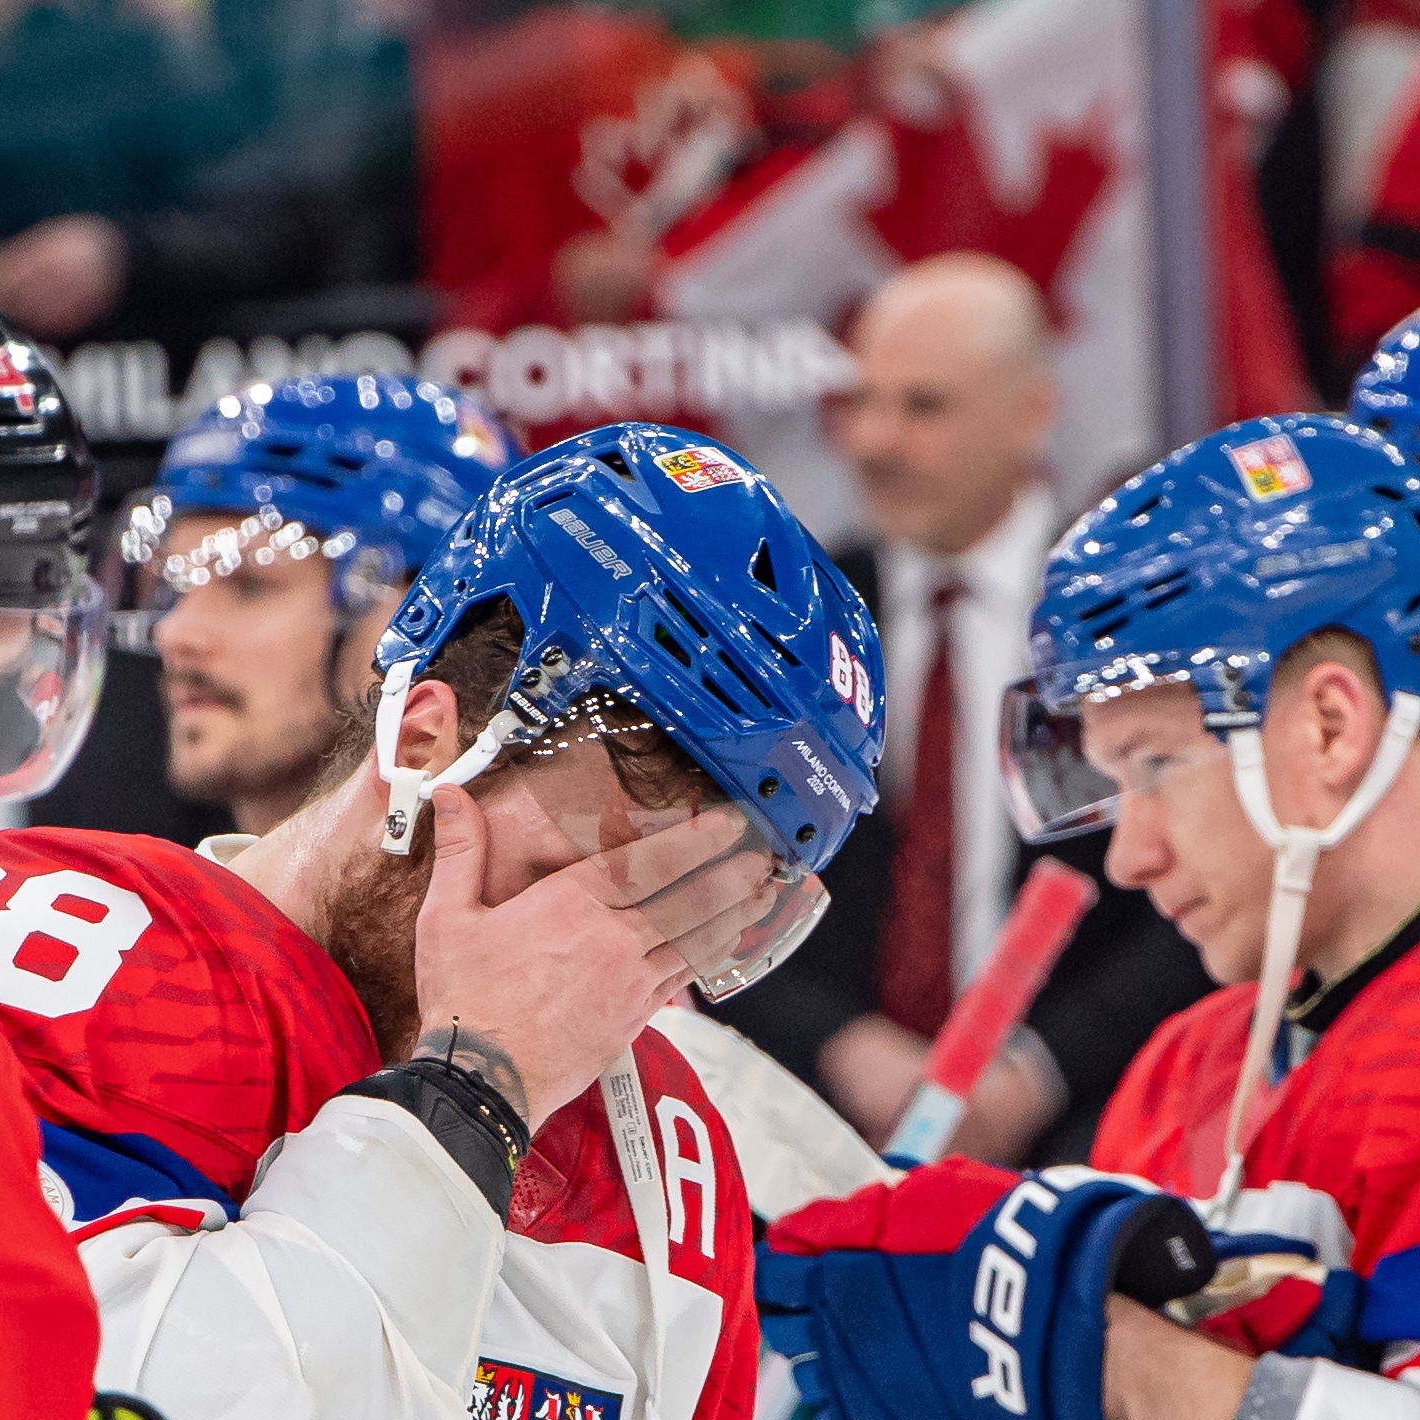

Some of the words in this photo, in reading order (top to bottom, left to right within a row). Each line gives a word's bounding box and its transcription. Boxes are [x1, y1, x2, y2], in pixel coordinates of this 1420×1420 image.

[547, 507, 634, 581] BAUER
[510, 691, 549, 725] BAUER
[829, 631, 872, 727] 88
[791, 740, 827, 778] MILANO
[823, 772, 853, 813] CORTINA
[806, 773, 827, 796] 2026
[654, 1095, 716, 1259] A
